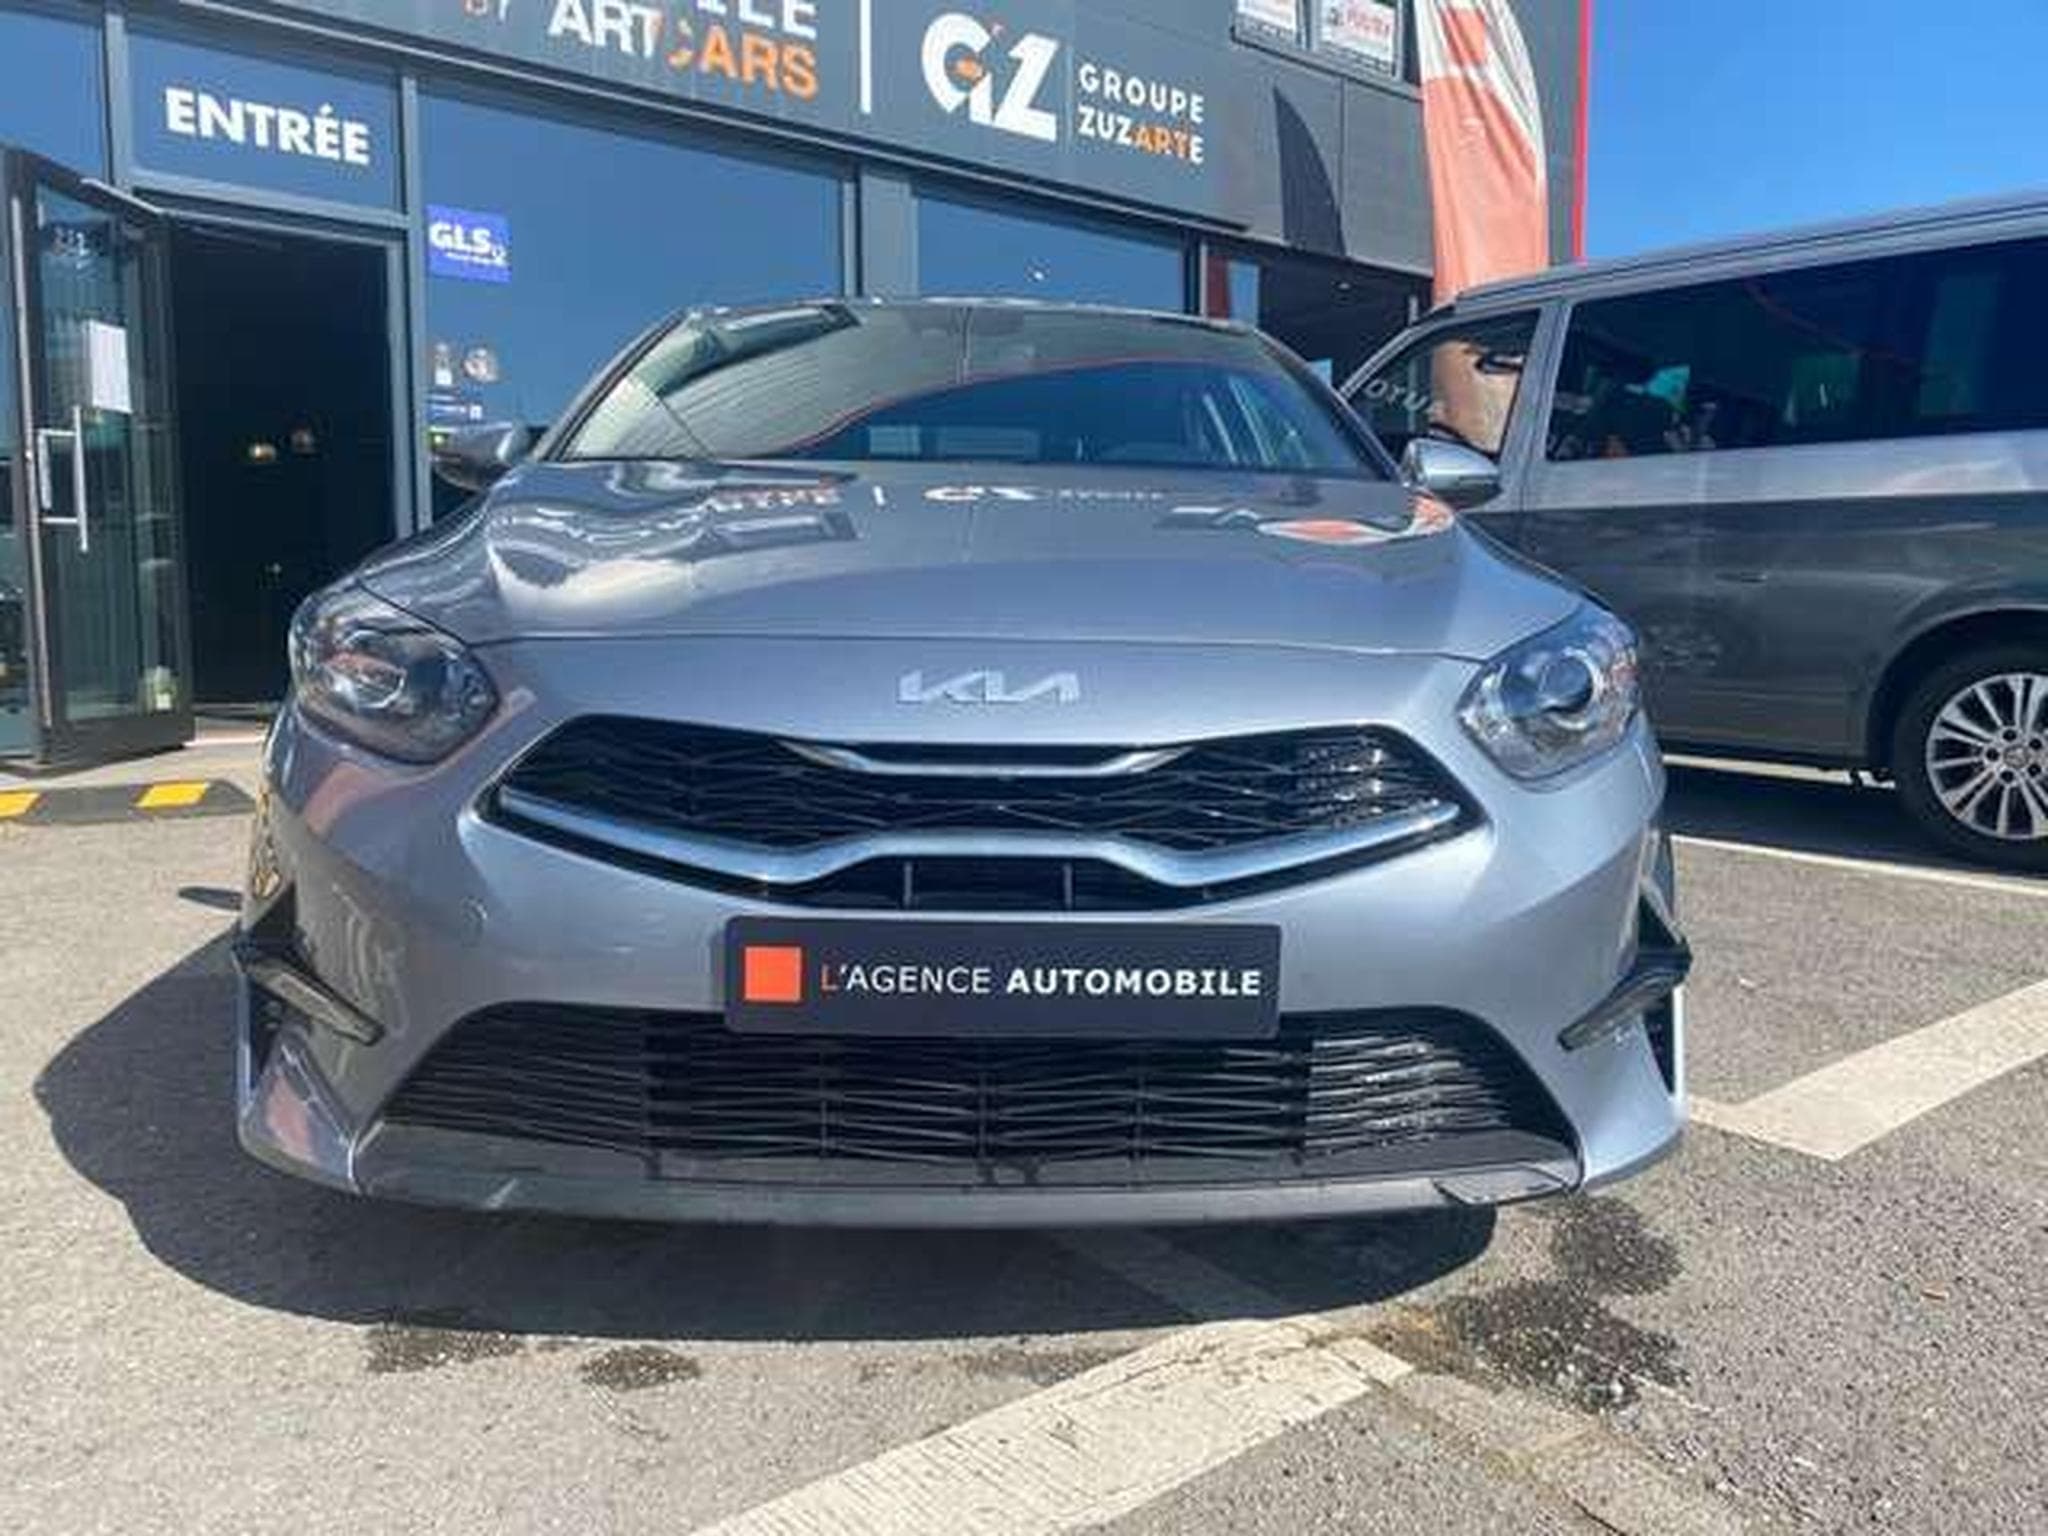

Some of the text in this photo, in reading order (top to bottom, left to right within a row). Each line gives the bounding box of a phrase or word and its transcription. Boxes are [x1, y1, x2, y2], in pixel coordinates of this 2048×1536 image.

[1078, 62, 1205, 123] GROUPE
[164, 87, 371, 166] ENTRÉE
[1077, 105, 1205, 165] ZUZARTE
[428, 221, 493, 255] GLS
[897, 669, 1081, 702] KIA
[820, 964, 1262, 997] L'AGENCE AUTOMOBILE
